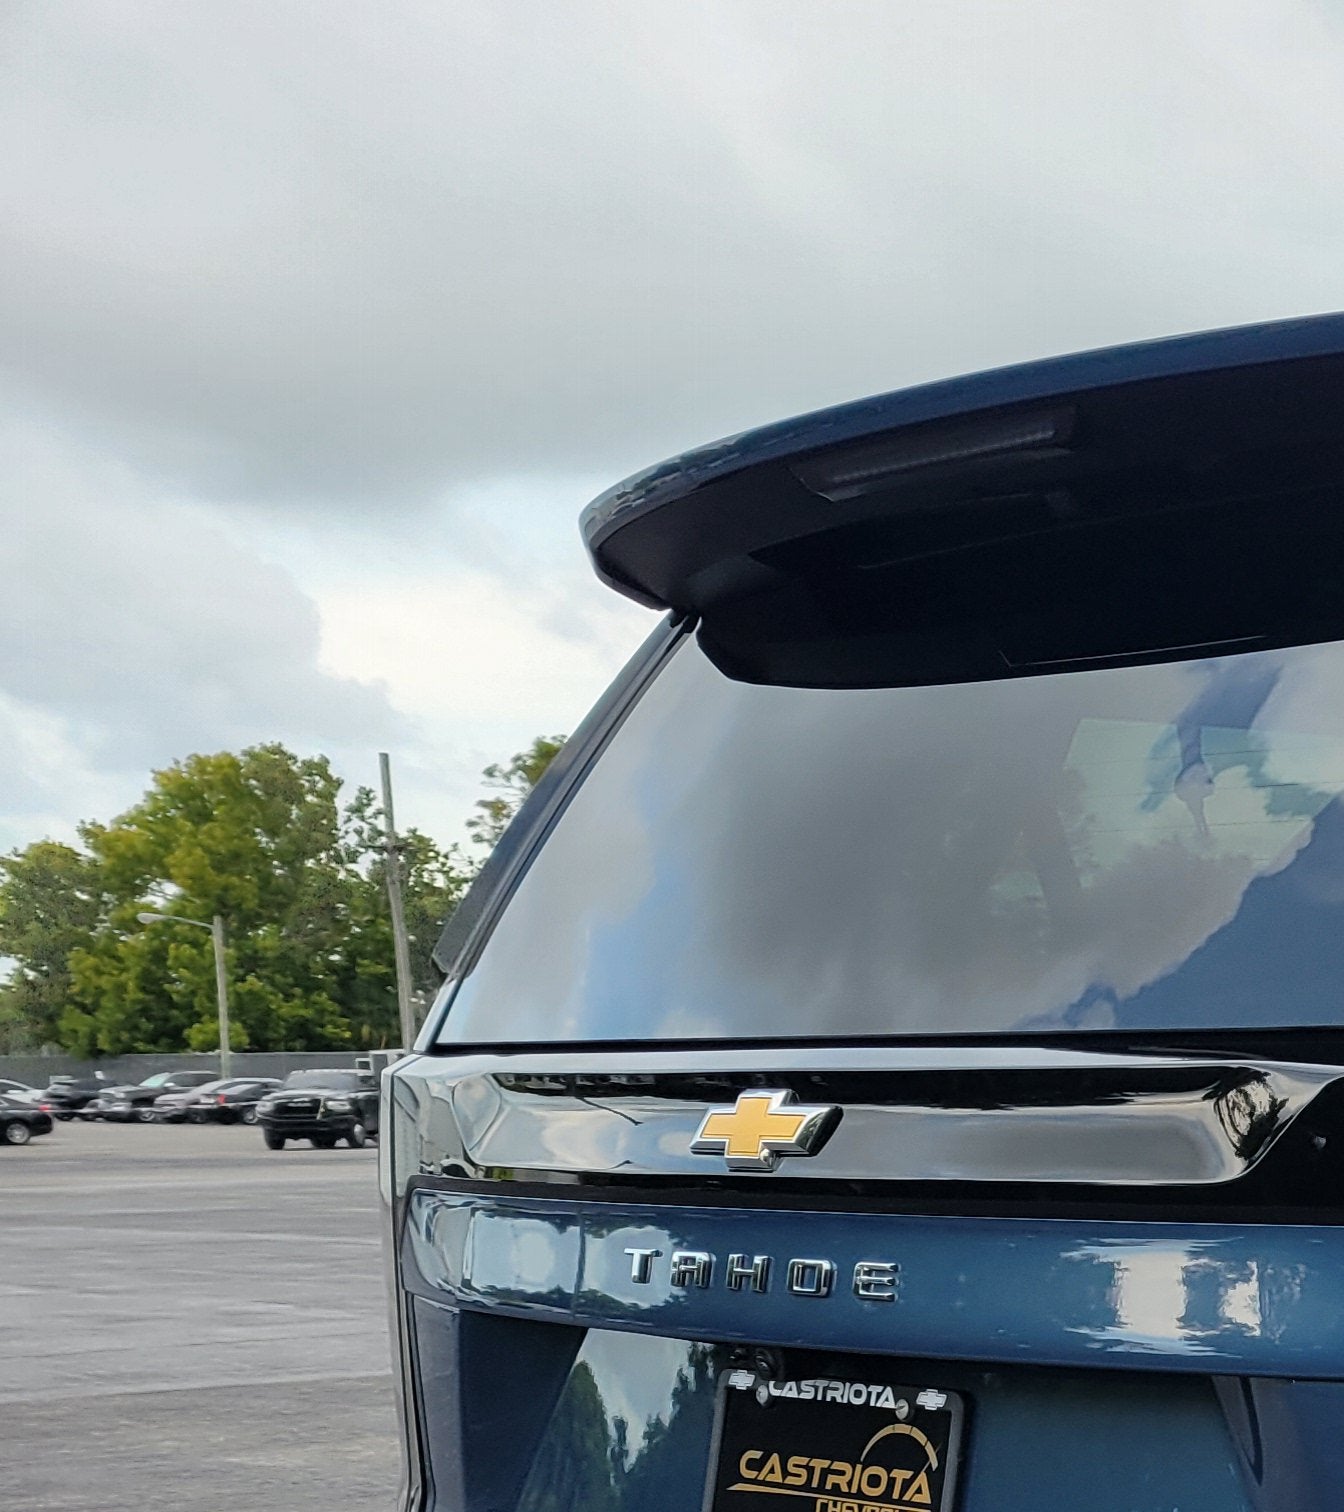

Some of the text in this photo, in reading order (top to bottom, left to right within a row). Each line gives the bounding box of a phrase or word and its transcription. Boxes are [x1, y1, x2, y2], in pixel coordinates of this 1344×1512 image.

[624, 1247, 901, 1302] TAHOE
[768, 1379, 896, 1408] CASTRIOTA
[739, 1449, 932, 1504] CASTRIOTA
